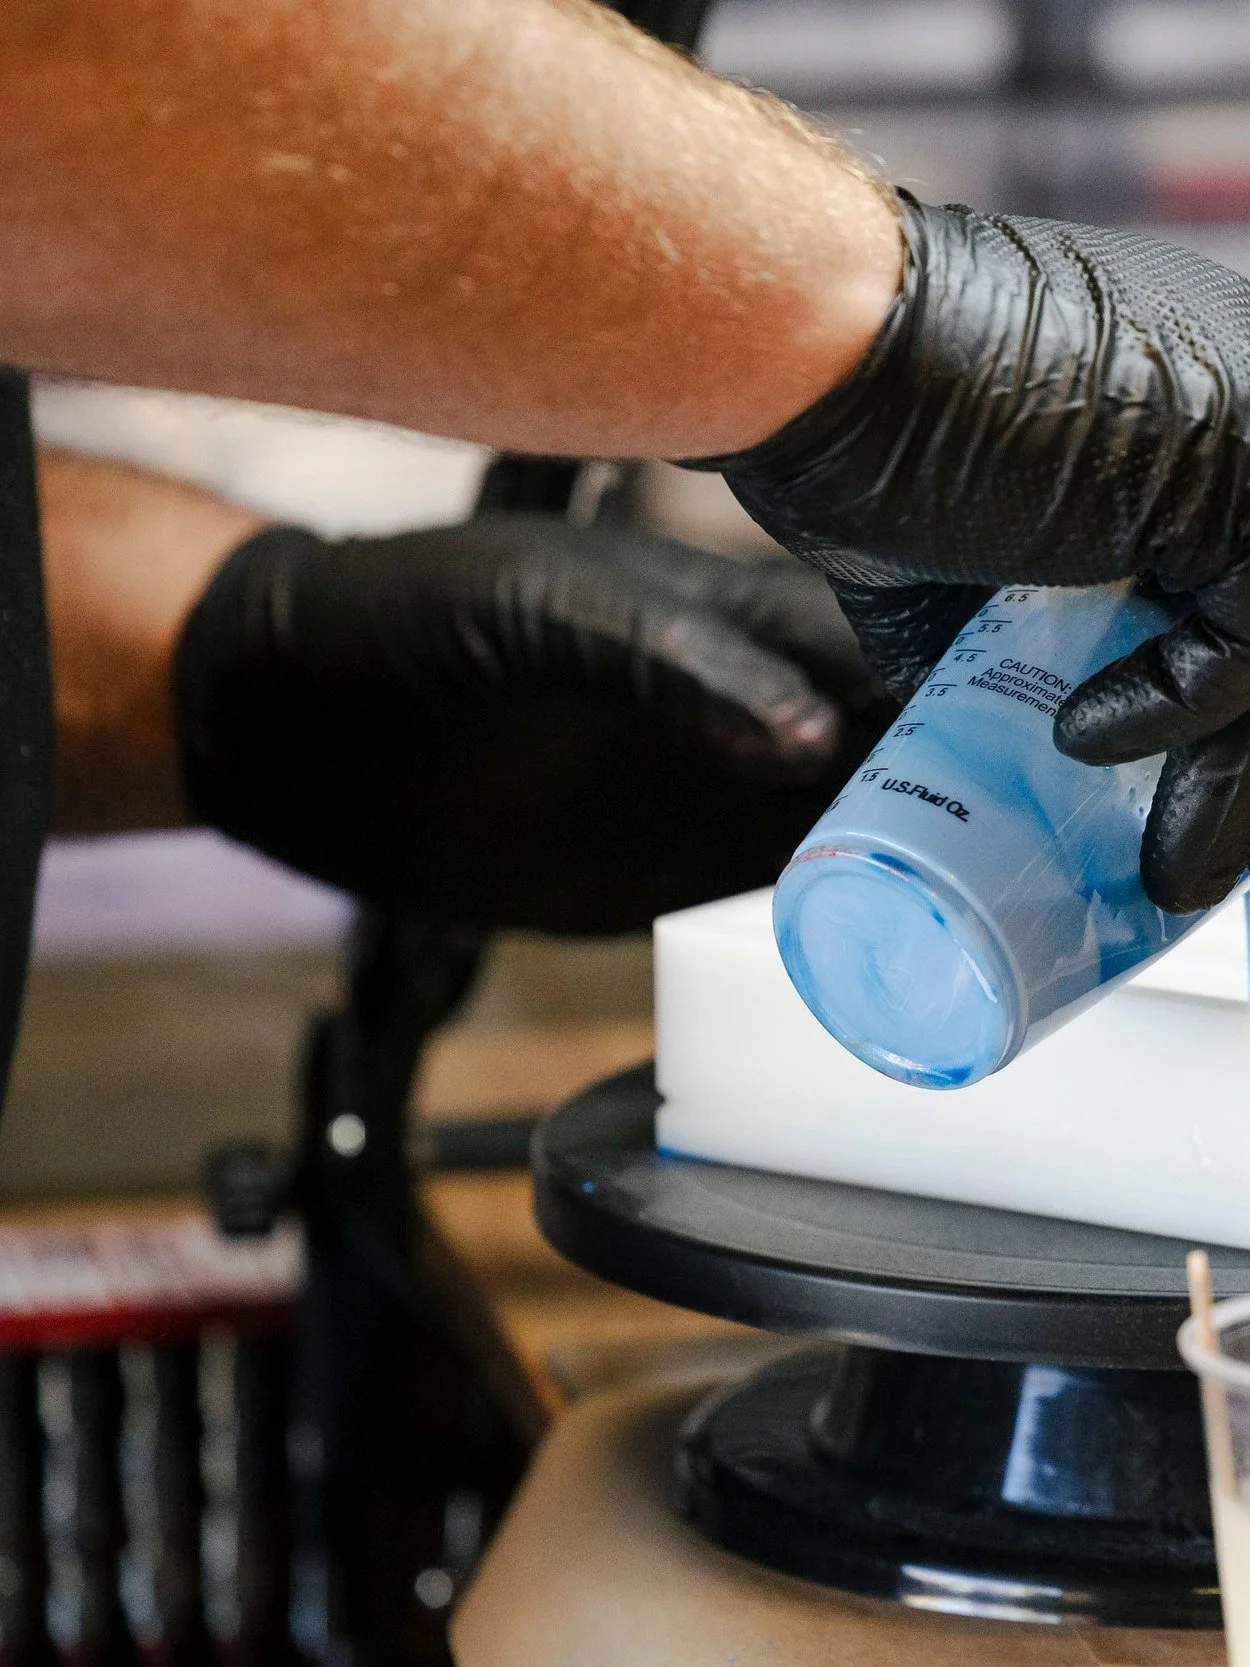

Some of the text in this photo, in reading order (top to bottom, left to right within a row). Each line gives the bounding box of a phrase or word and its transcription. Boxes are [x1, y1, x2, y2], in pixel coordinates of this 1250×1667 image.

[1004, 593, 1030, 602] 6.5
[977, 623, 1003, 633] 5.5
[999, 658, 1072, 694] CAUTION:
[925, 687, 948, 697] 3.5
